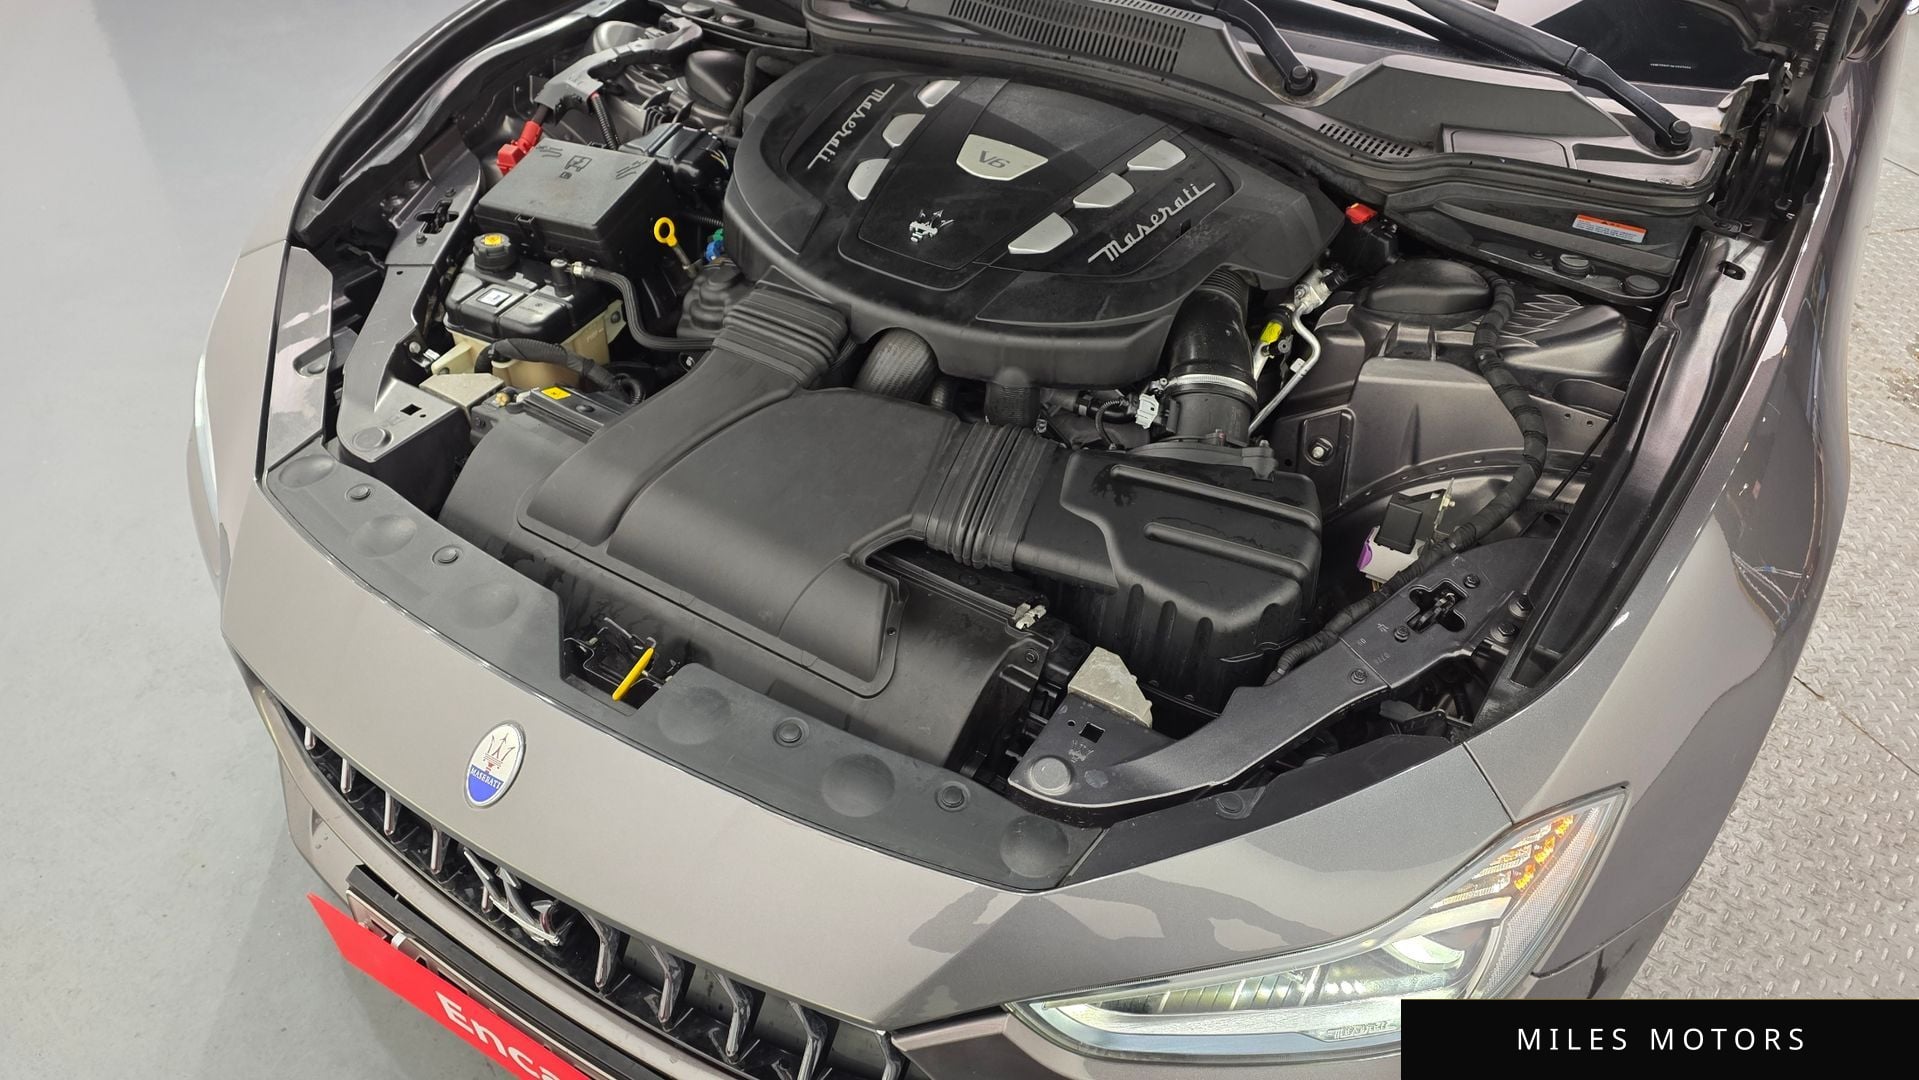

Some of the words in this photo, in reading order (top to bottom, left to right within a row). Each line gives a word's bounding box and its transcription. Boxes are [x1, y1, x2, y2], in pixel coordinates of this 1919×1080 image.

[807, 83, 895, 169] Maserati
[979, 150, 1011, 168] V6
[1087, 182, 1216, 263] Maserati
[471, 766, 502, 790] MASERATI
